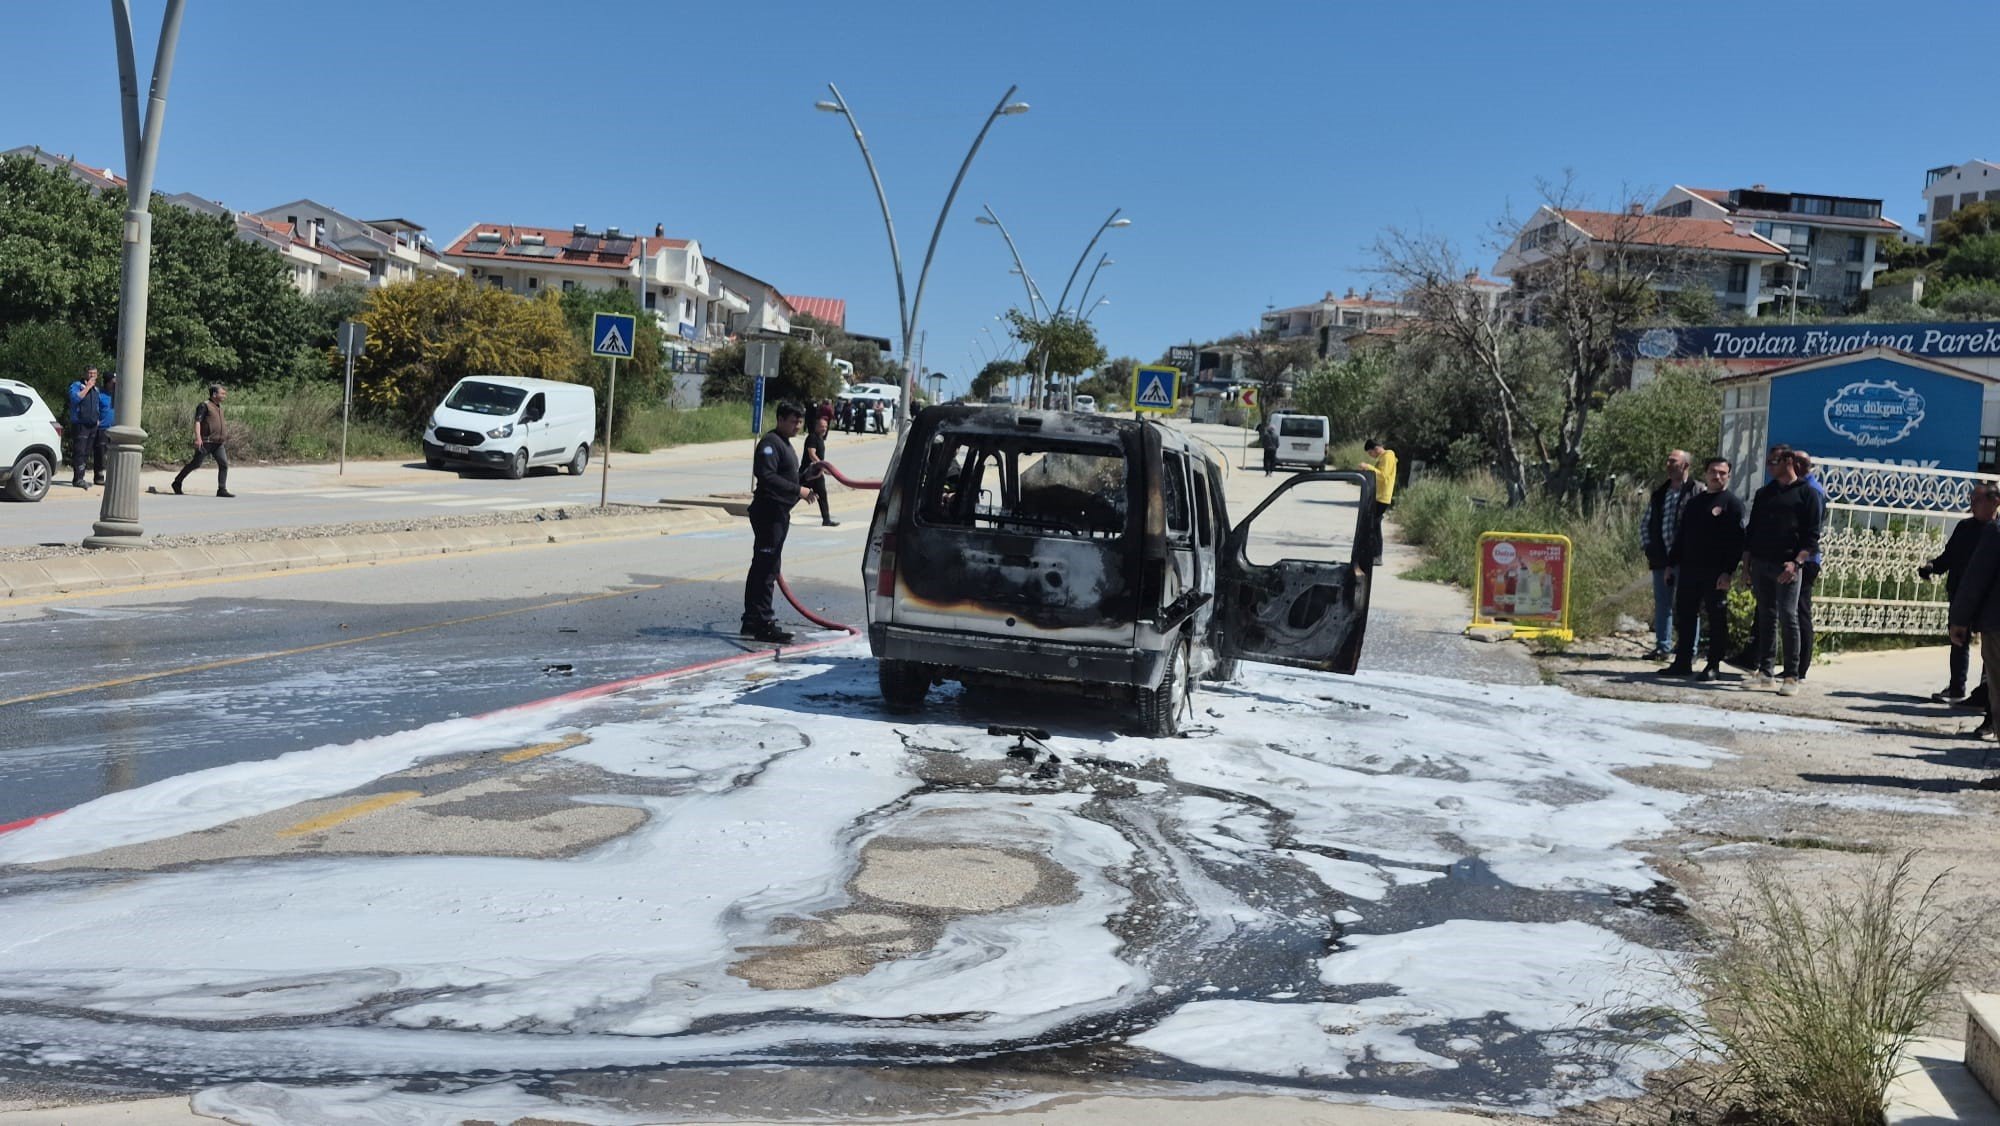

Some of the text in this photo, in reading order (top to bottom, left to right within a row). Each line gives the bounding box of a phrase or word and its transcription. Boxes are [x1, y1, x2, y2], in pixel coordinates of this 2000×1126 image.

[1713, 331, 1797, 358] Toptan
[1835, 402, 1860, 416] goca
[1863, 400, 1903, 417] dükgan
